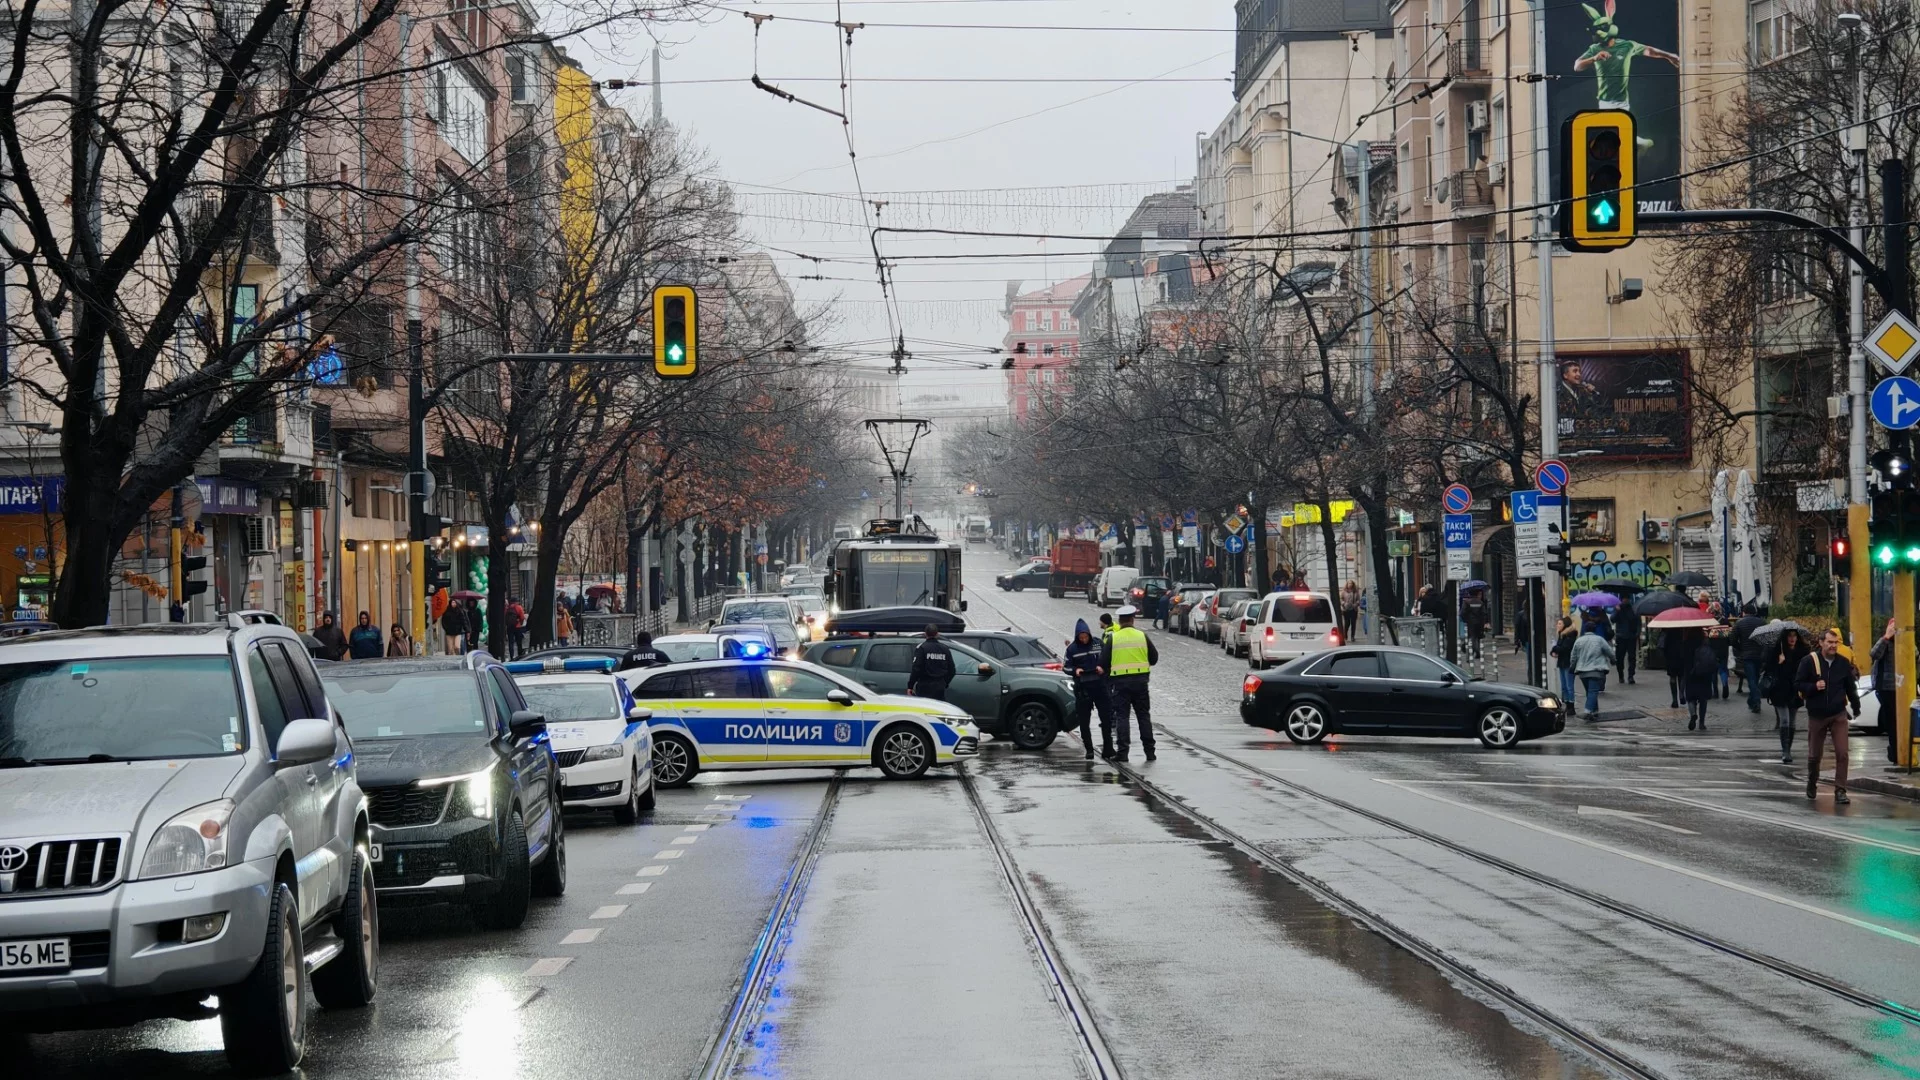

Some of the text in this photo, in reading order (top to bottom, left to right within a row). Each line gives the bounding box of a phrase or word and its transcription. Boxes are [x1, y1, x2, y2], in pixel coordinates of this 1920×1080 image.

[1638, 201, 1671, 213] РАТА!
[1446, 522, 1471, 530] ТАКСИ
[632, 653, 656, 661] POLICE
[725, 724, 822, 741] ПОЛИЦИЯ
